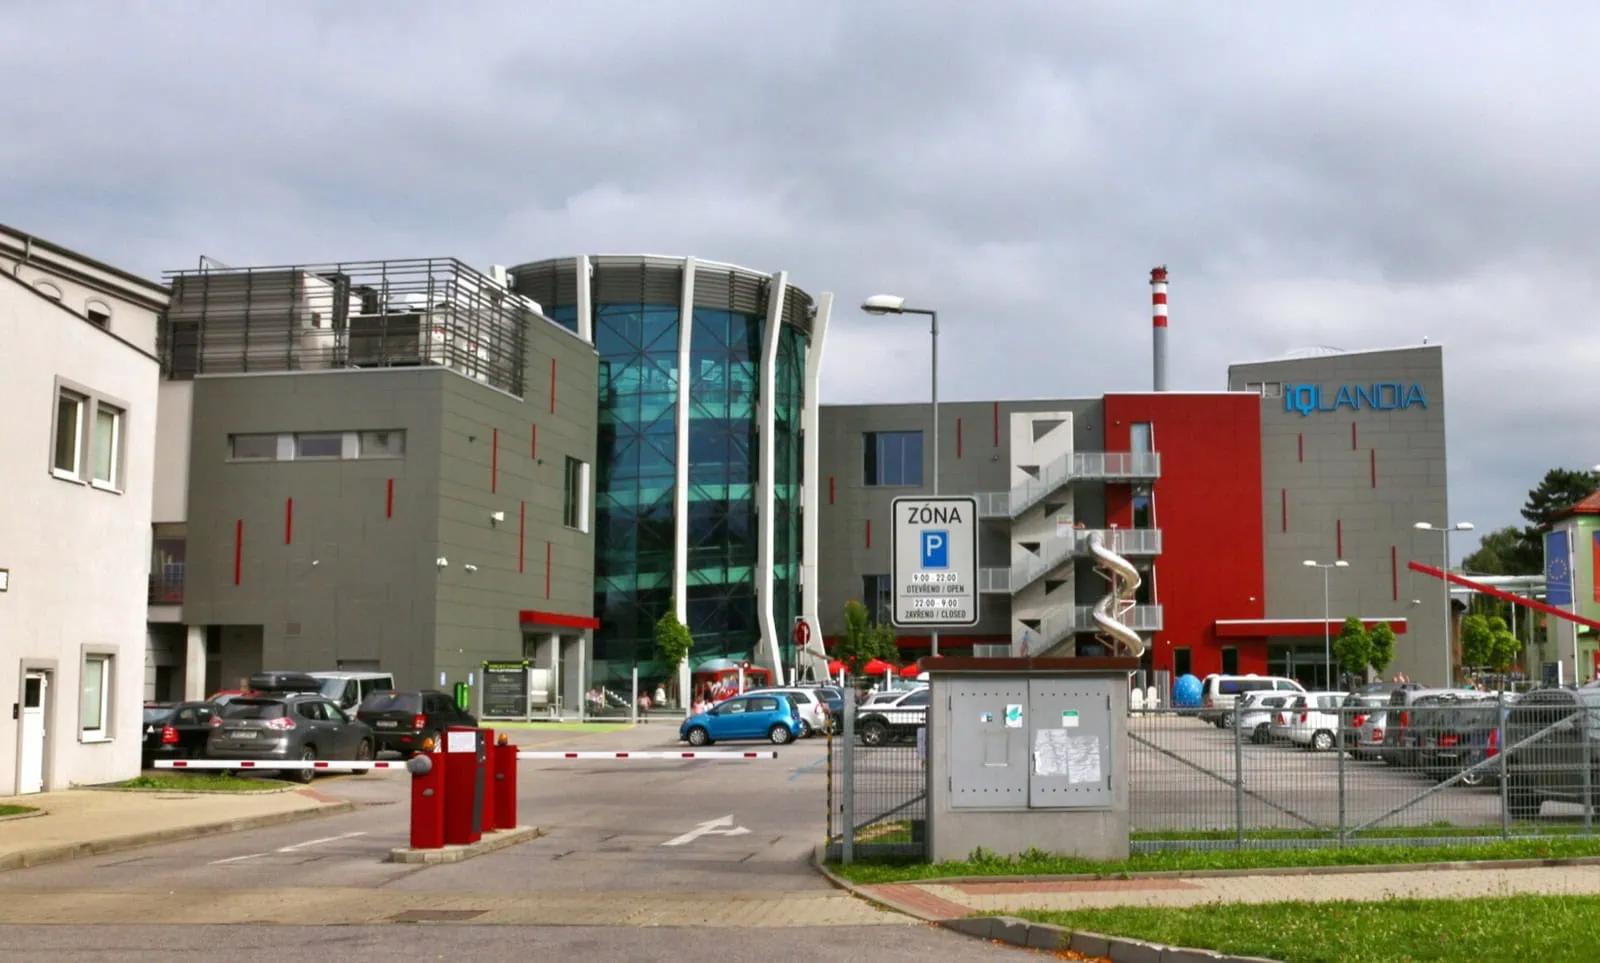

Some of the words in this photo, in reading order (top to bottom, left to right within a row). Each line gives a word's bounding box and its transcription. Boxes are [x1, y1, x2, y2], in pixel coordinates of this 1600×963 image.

[908, 502, 962, 524] ZÓNA
[926, 534, 943, 557] P
[906, 583, 940, 593] OTEVŘENO
[947, 585, 965, 593] OPEN
[905, 609, 934, 618] ZAVŘENO
[941, 610, 966, 618] CLOSED
